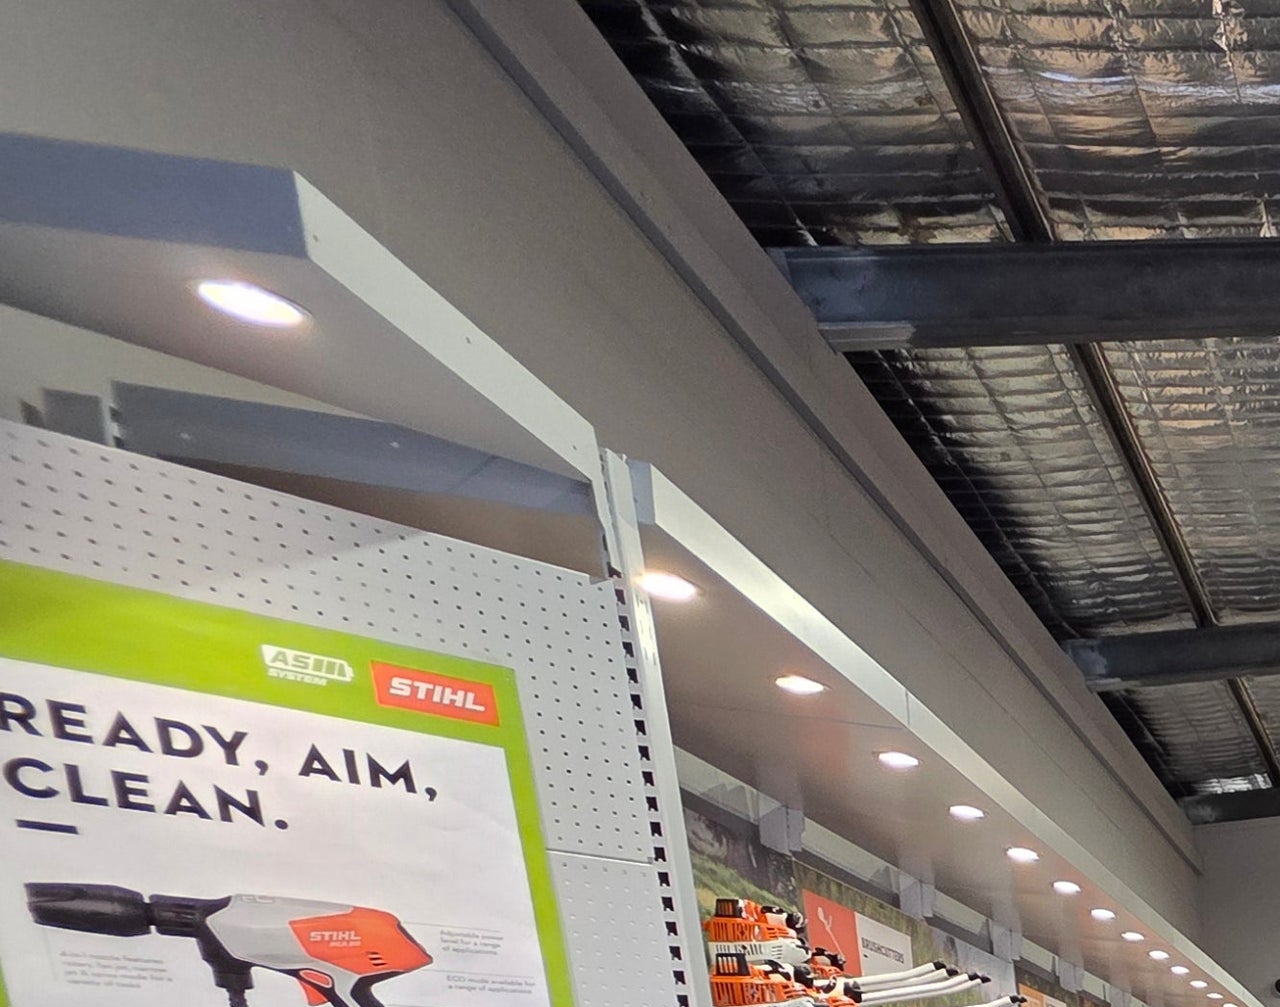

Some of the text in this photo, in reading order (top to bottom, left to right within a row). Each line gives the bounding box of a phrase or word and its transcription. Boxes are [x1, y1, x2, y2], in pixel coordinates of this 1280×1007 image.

[267, 667, 328, 686] SYSTEM
[389, 676, 485, 712] STIHL
[0, 691, 437, 802] READY, AIM,
[2, 757, 289, 830] CLEAN.
[310, 930, 361, 943] STIHL
